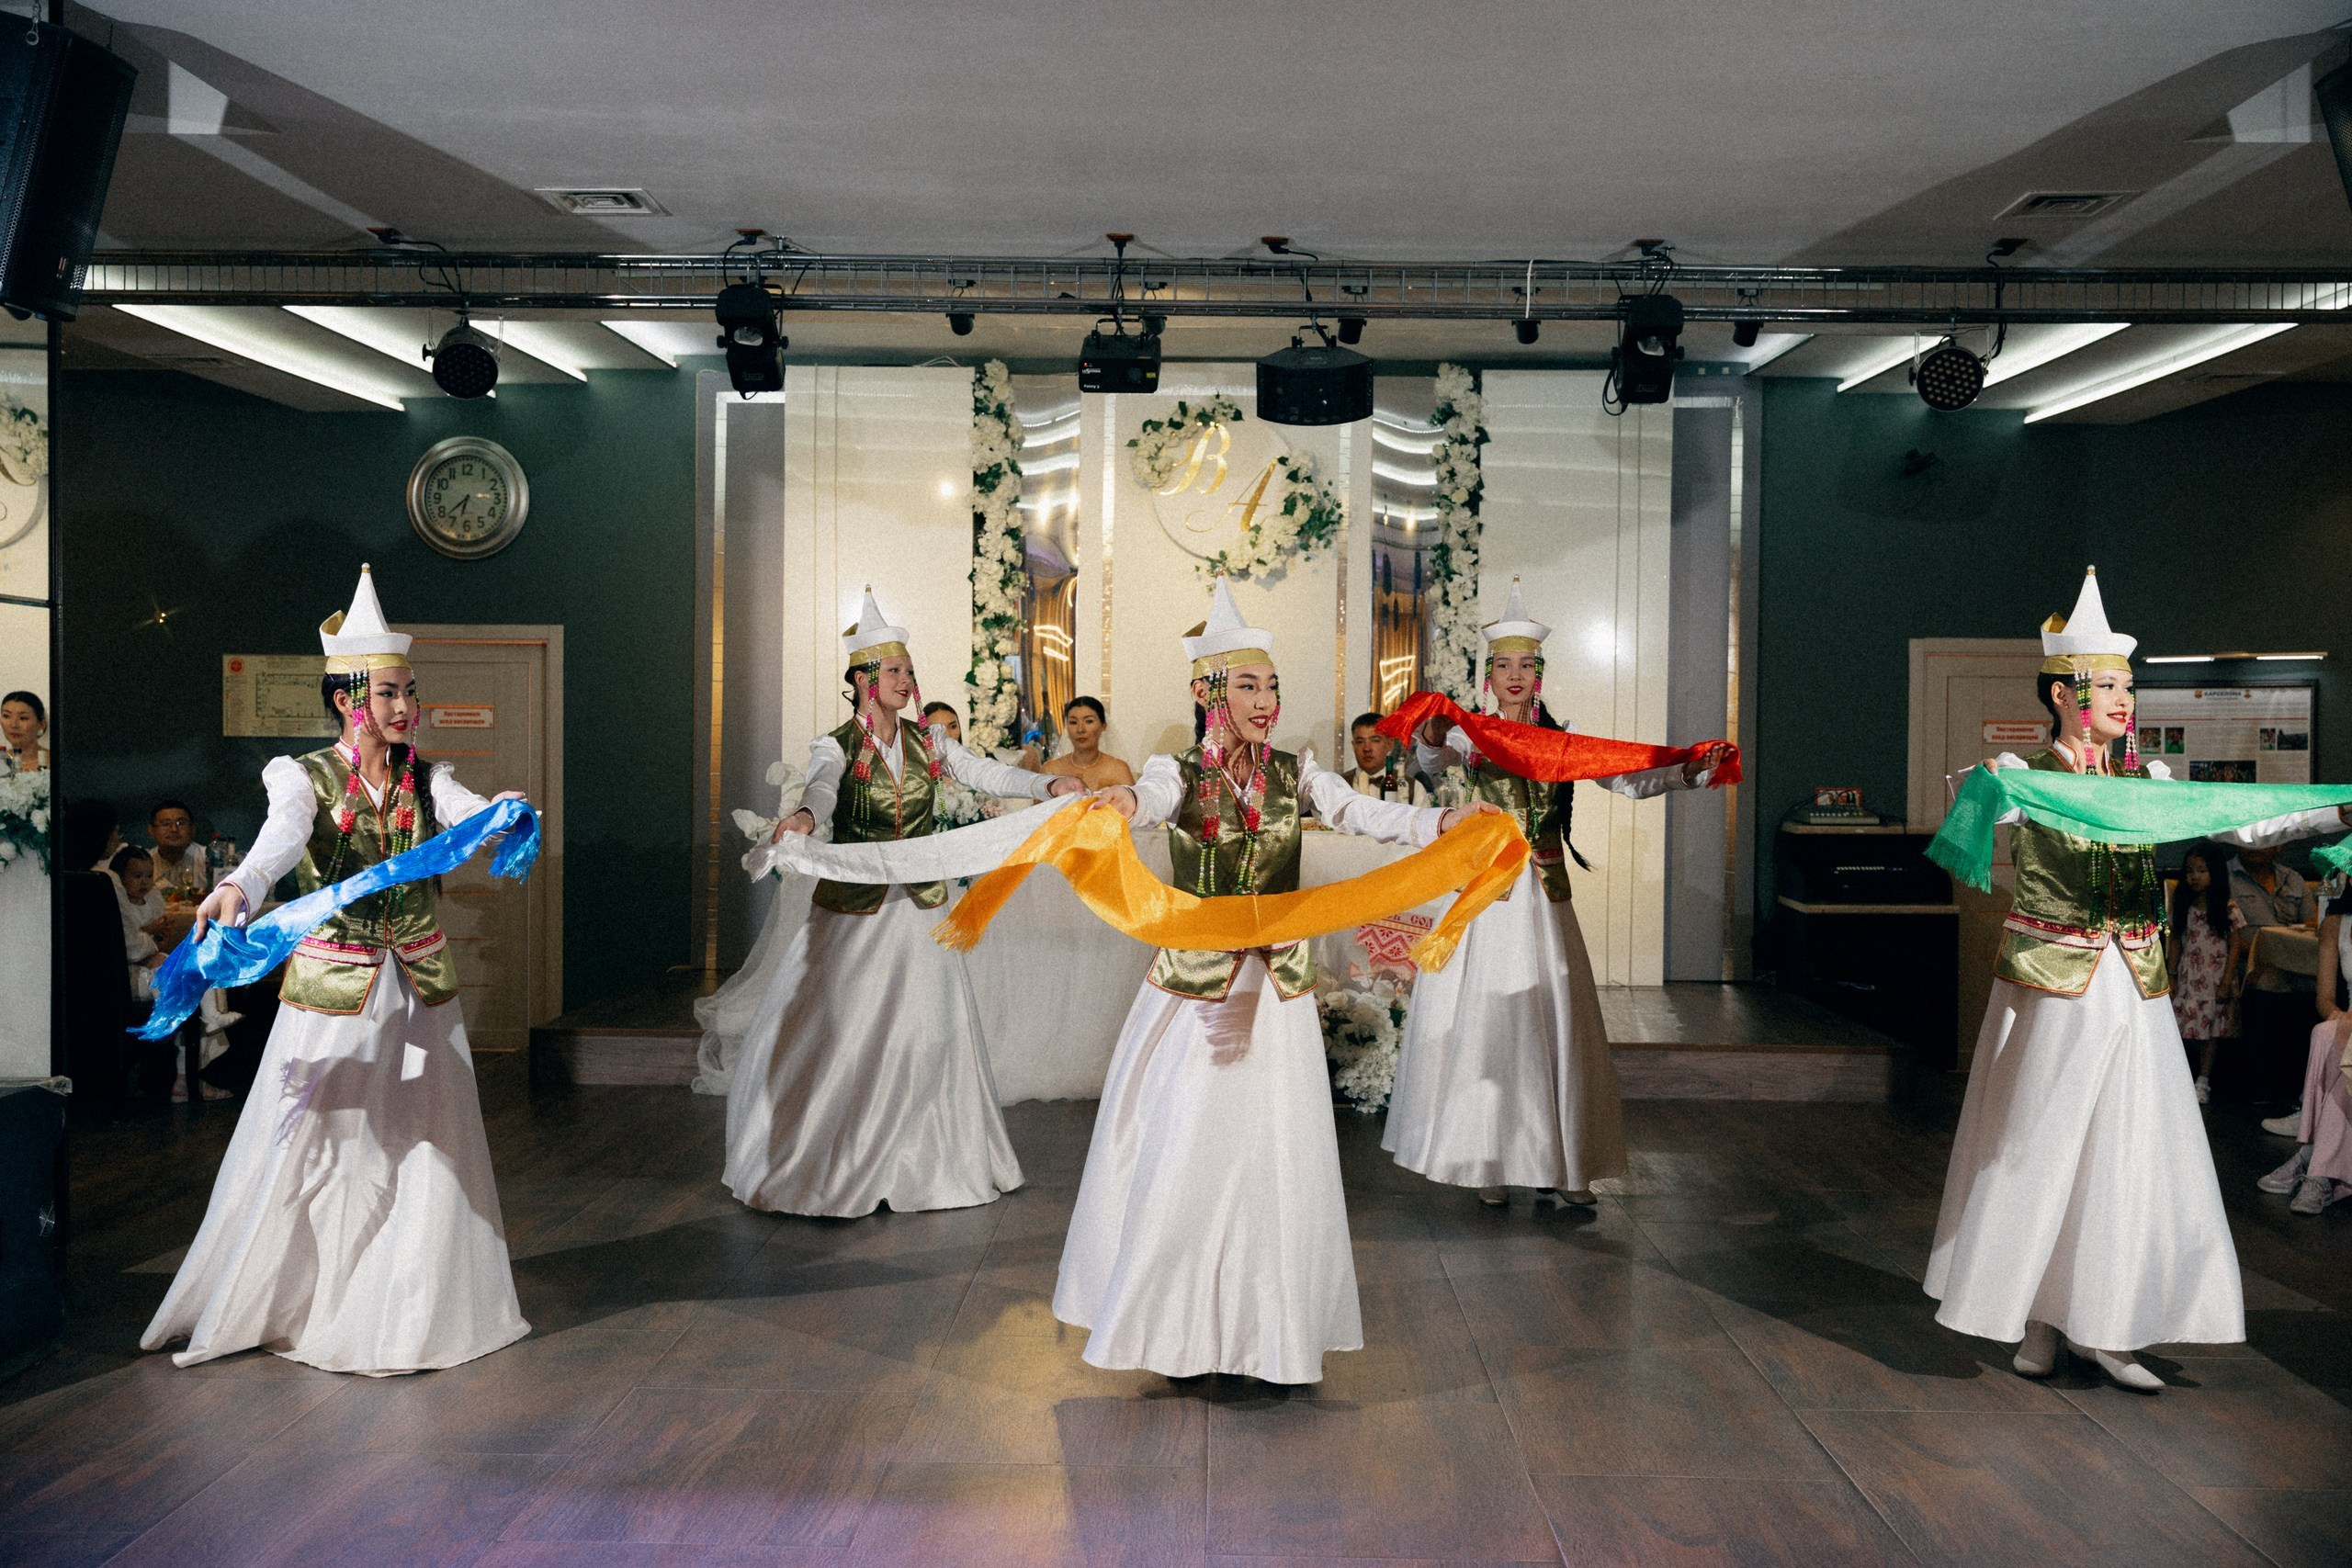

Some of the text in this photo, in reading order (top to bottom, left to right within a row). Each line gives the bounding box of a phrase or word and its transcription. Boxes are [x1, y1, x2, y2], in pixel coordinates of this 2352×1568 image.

[448, 468, 456, 479] 11
[462, 463, 474, 477] 12
[481, 468, 486, 479] 1
[436, 479, 449, 491] 10
[489, 479, 497, 491] 2
[433, 492, 441, 504] 9
[493, 492, 502, 505] 3
[437, 506, 446, 518] 8
[488, 506, 496, 519] 4
[448, 516, 457, 528] 7
[462, 520, 471, 533] 6
[477, 516, 485, 528] 5
